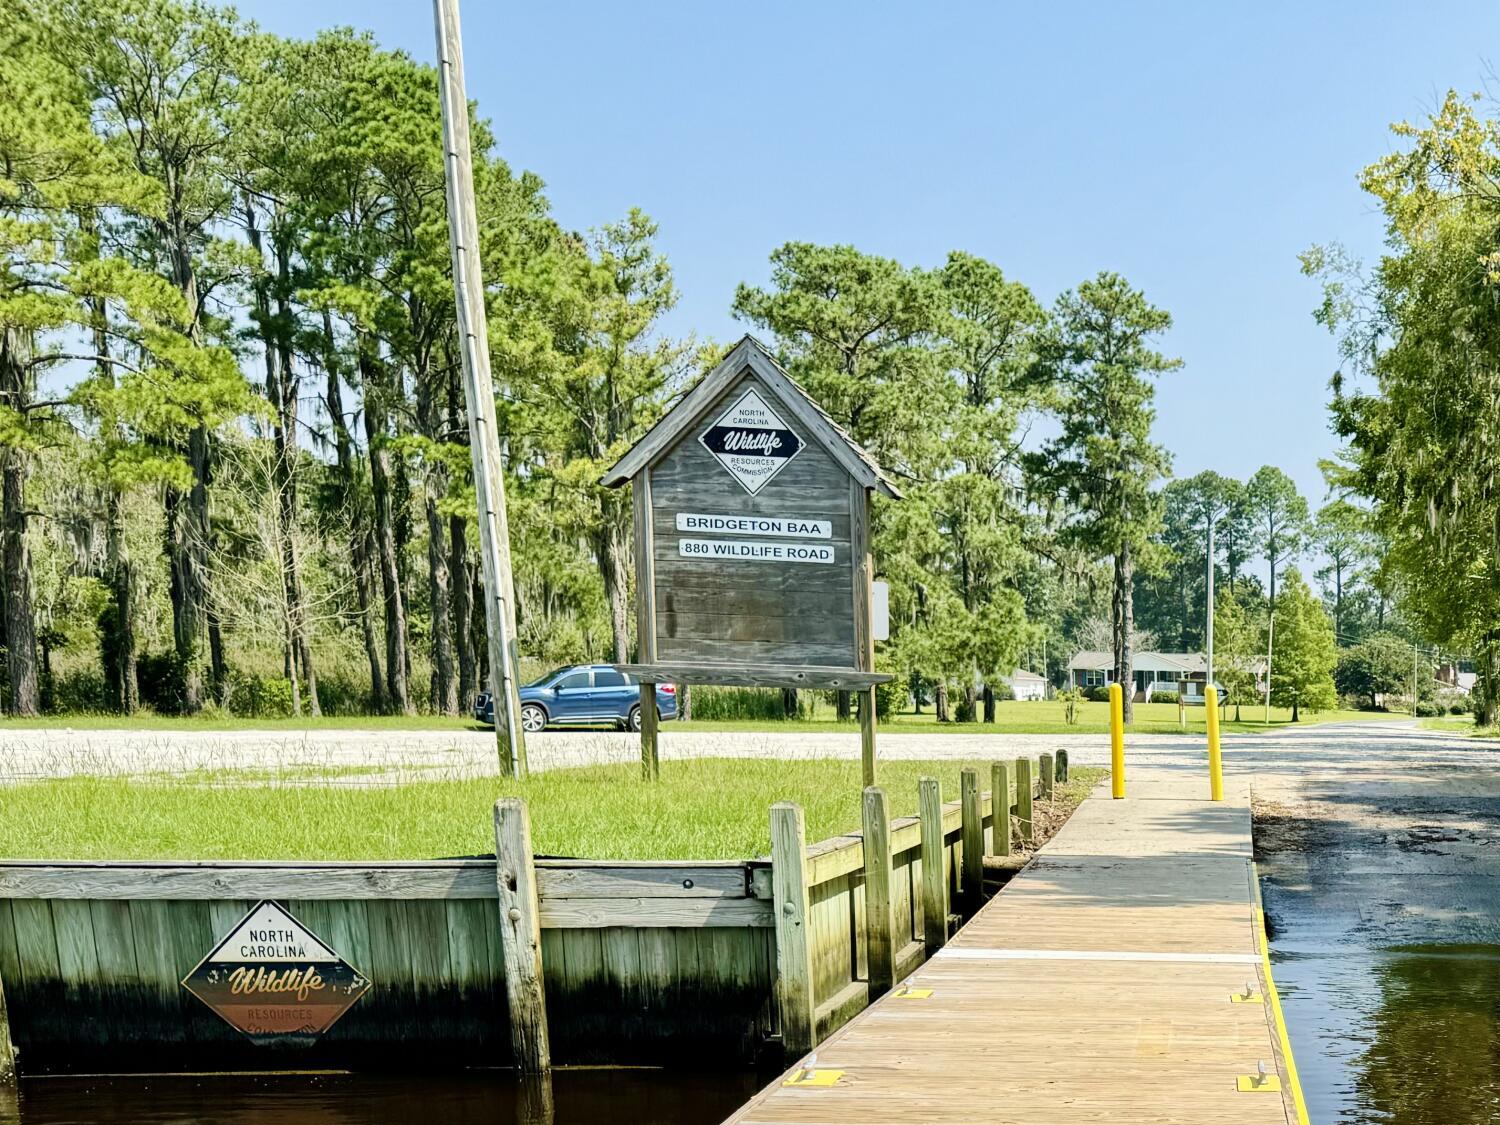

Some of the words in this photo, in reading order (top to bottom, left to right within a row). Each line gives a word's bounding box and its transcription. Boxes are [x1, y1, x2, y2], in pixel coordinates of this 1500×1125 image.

[739, 409, 765, 417] NORTH
[732, 417, 769, 426] CAROLINA
[723, 430, 783, 456] Wildlife
[730, 457, 775, 466] RESOURCES
[732, 464, 773, 477] COMMISSION
[686, 517, 782, 533] BRIDGETON
[787, 523, 822, 535] BAA
[684, 542, 709, 554] 880
[713, 544, 783, 558] WILDLIFE
[787, 548, 830, 560] ROAD
[249, 930, 294, 943] NORTH
[240, 945, 306, 958] CAROLINA
[228, 965, 326, 1001] Wildlife
[247, 1008, 313, 1020] RESOURCES
